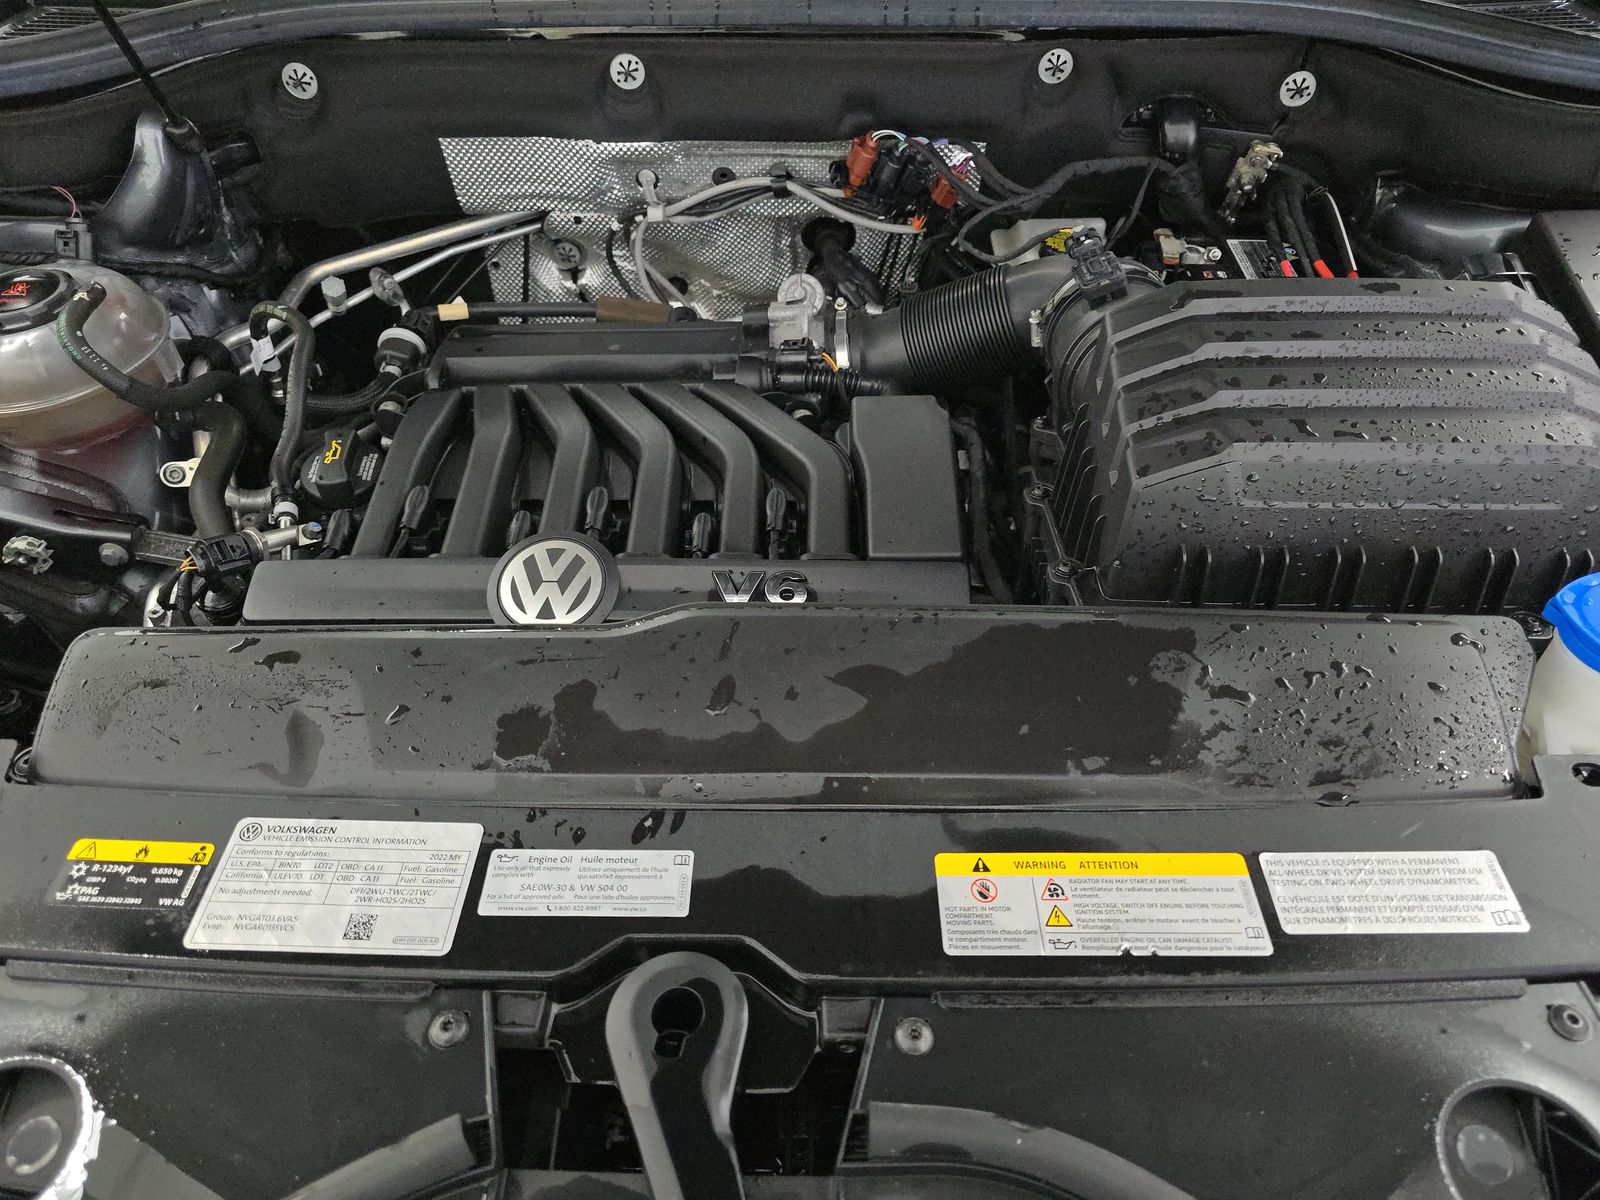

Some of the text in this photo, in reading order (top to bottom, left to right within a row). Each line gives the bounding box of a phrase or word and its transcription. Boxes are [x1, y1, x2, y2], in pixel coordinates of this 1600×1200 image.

[711, 570, 808, 603] V6
[267, 825, 337, 835] VOLKSWAGEN
[334, 836, 370, 844] CONTROL
[372, 837, 428, 846] INFORMATION
[236, 849, 273, 857] Conforms
[284, 850, 330, 860] regulations:
[429, 853, 447, 861] 2022
[528, 856, 558, 865] Engine
[606, 856, 638, 864] moteur
[92, 863, 183, 876] R-1234yf 0.650 kg
[313, 862, 334, 870] LDT2
[425, 866, 459, 874] Gasoline
[1014, 861, 1139, 869] WARNING ATTENTION
[80, 887, 100, 895] PAG
[232, 887, 280, 896] adjustments
[282, 888, 313, 896] needed.
[159, 898, 185, 907] VW AG
